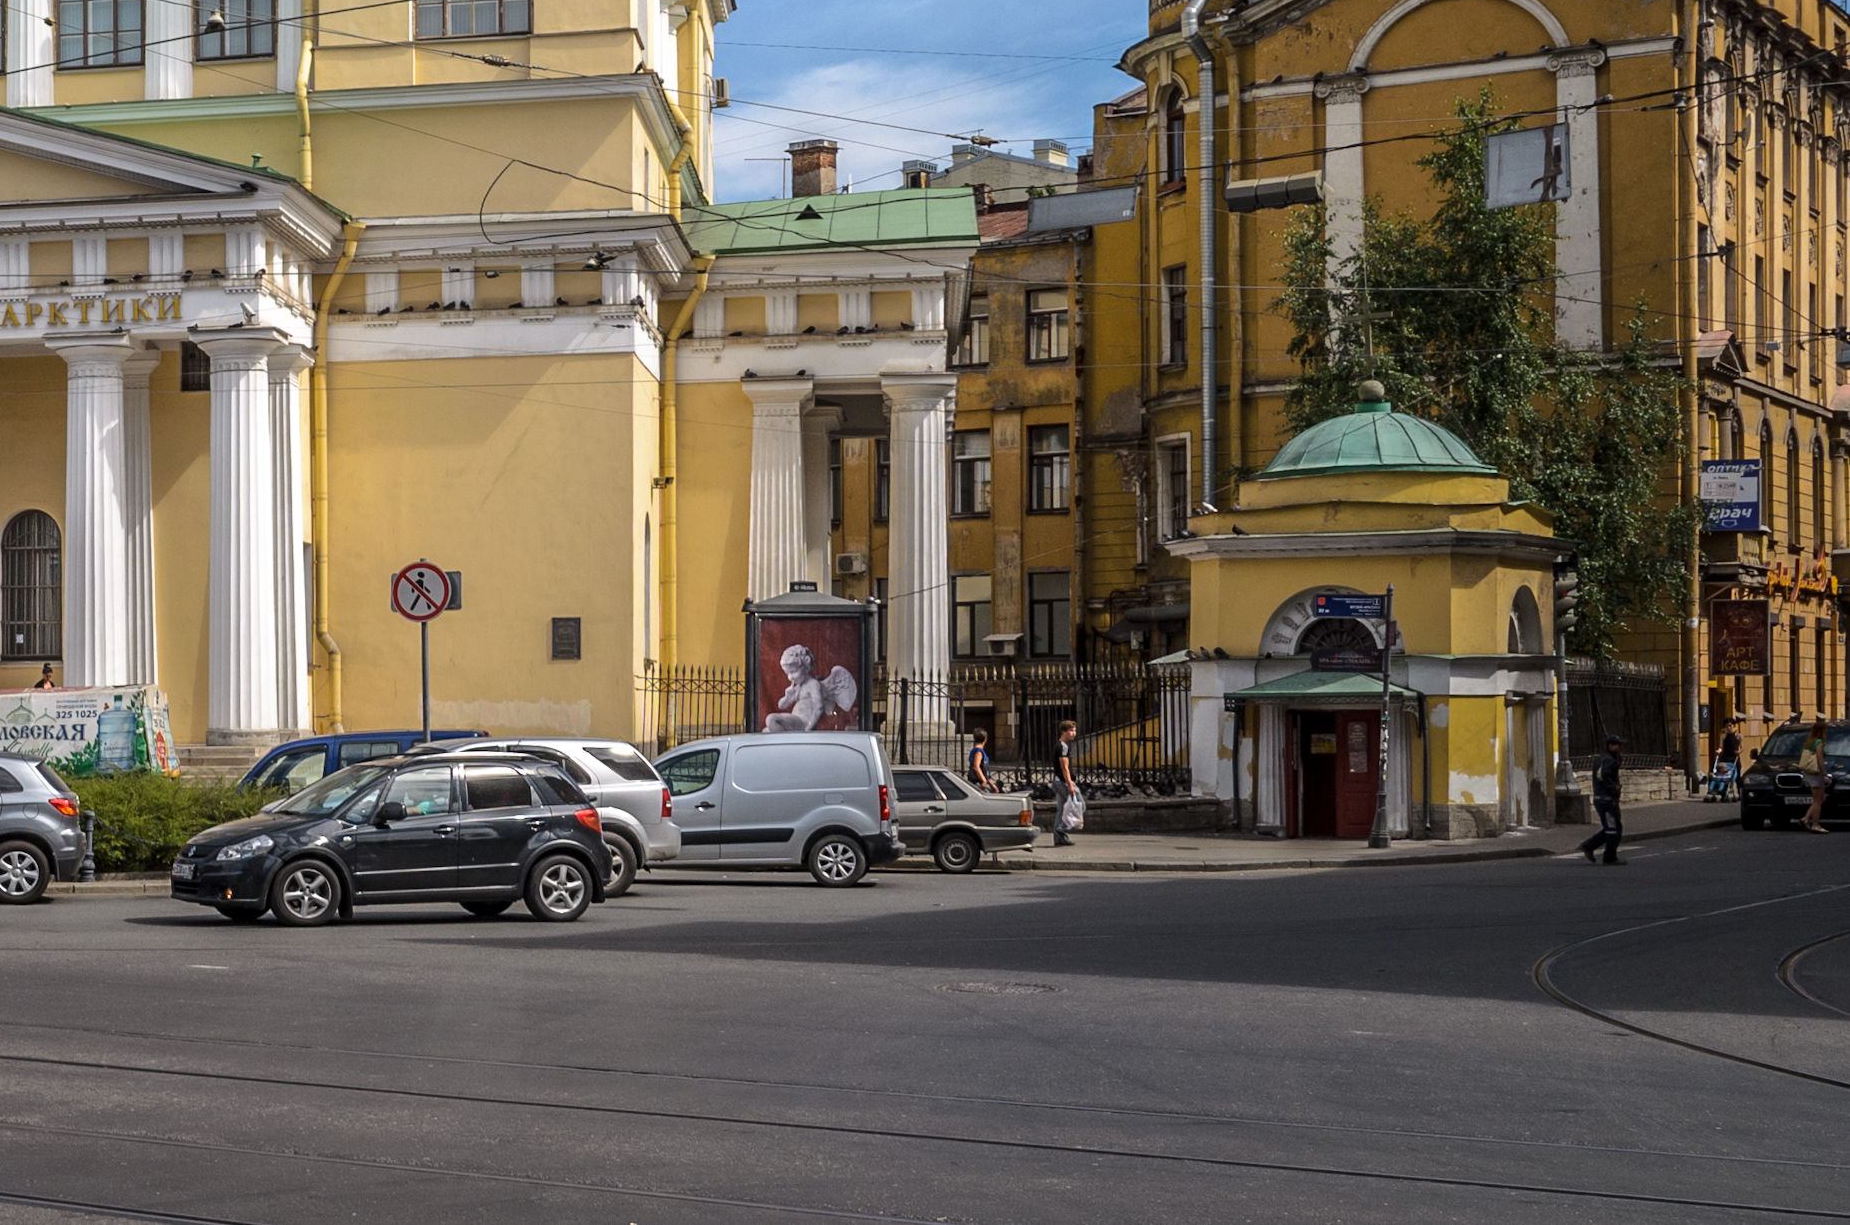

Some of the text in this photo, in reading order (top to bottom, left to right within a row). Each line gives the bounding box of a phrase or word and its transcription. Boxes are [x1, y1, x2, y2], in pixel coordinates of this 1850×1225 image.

[1726, 646, 1755, 658] АРТ
[1721, 659, 1760, 671] КАФЕ
[55, 709, 98, 719] 325 1025
